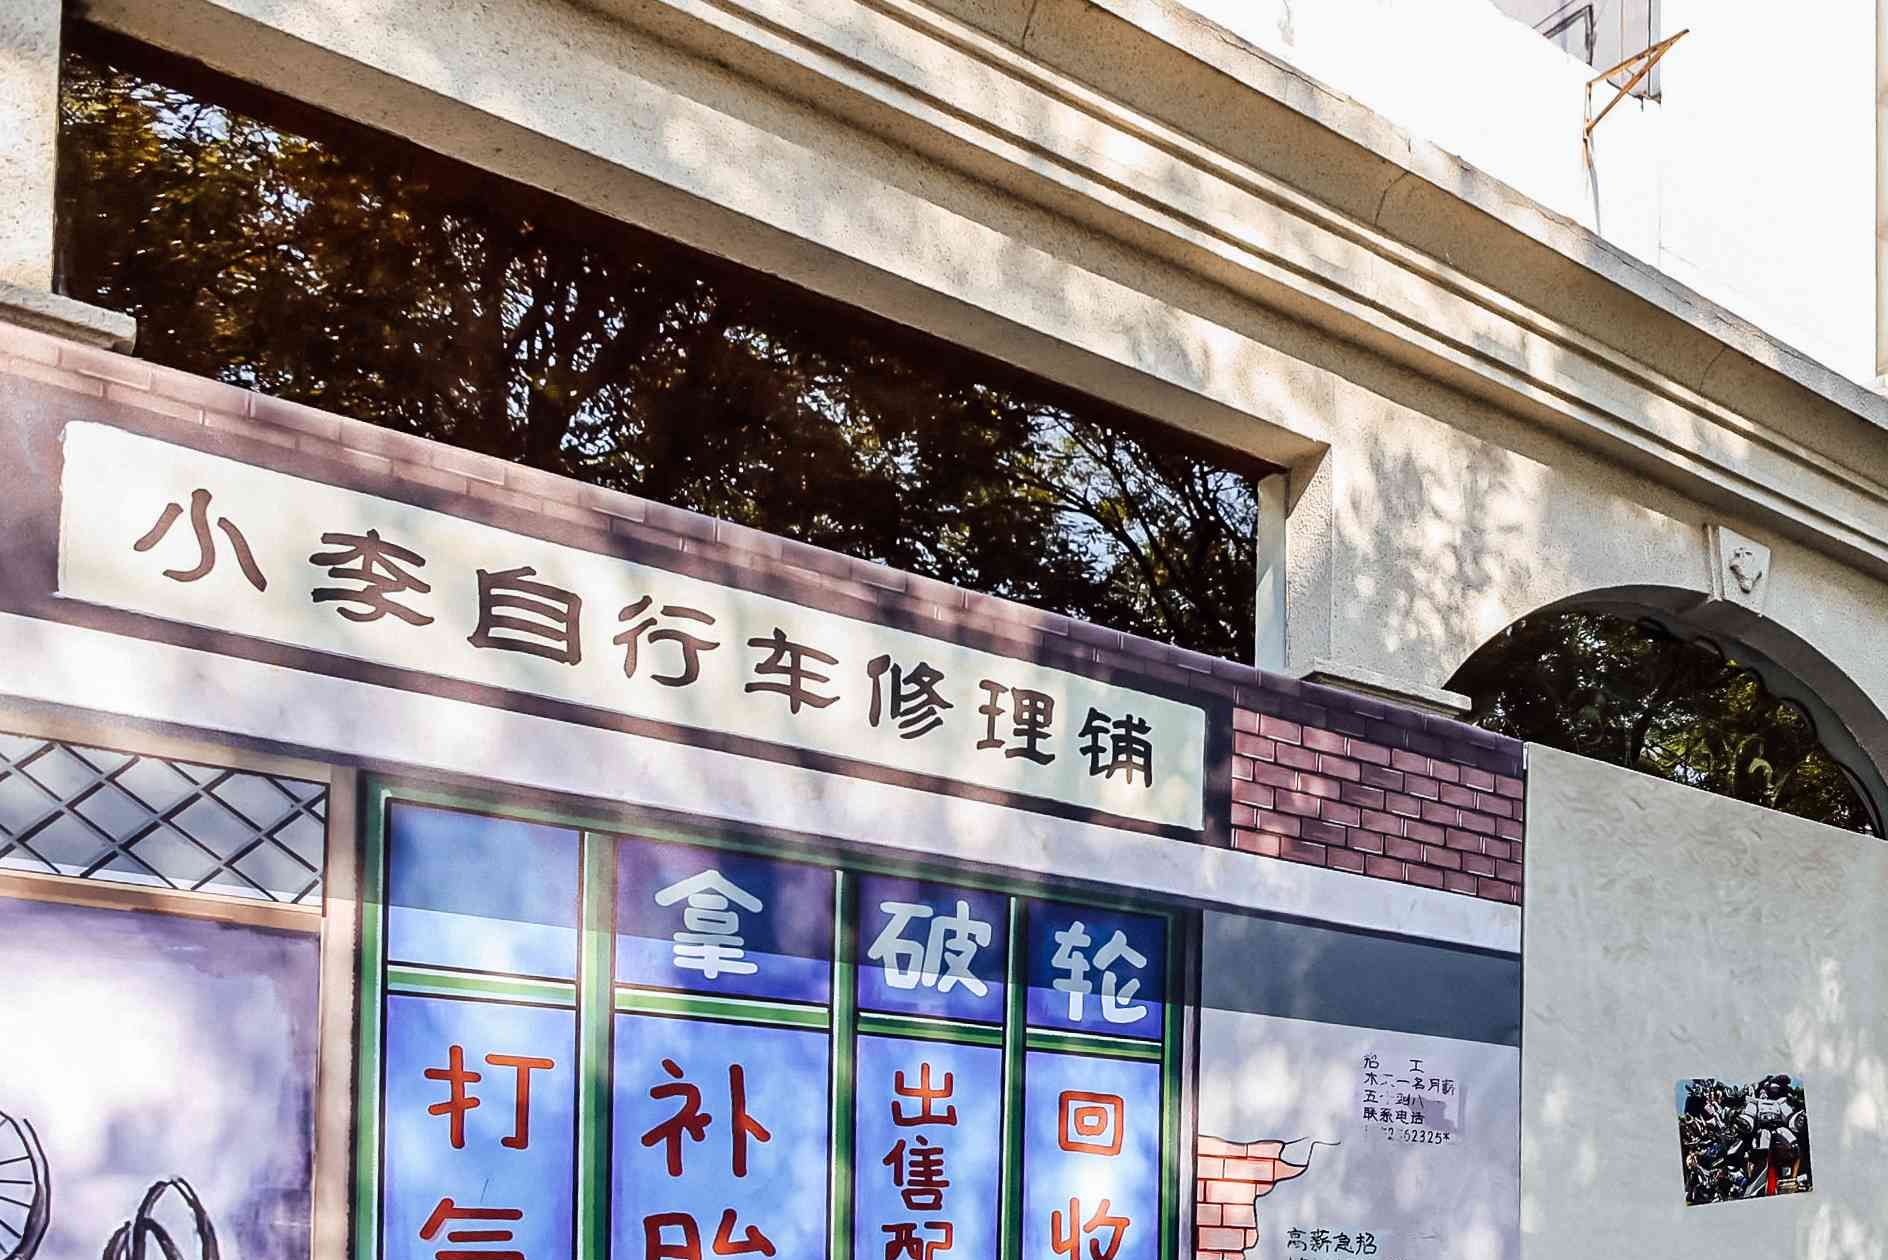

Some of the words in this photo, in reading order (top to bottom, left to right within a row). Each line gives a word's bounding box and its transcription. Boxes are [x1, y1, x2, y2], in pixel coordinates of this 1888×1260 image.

[133, 487, 1156, 789] 小李自行车修理铺
[1362, 1106, 1426, 1125] 联系电话
[1286, 1227, 1377, 1256] 高薪急招
